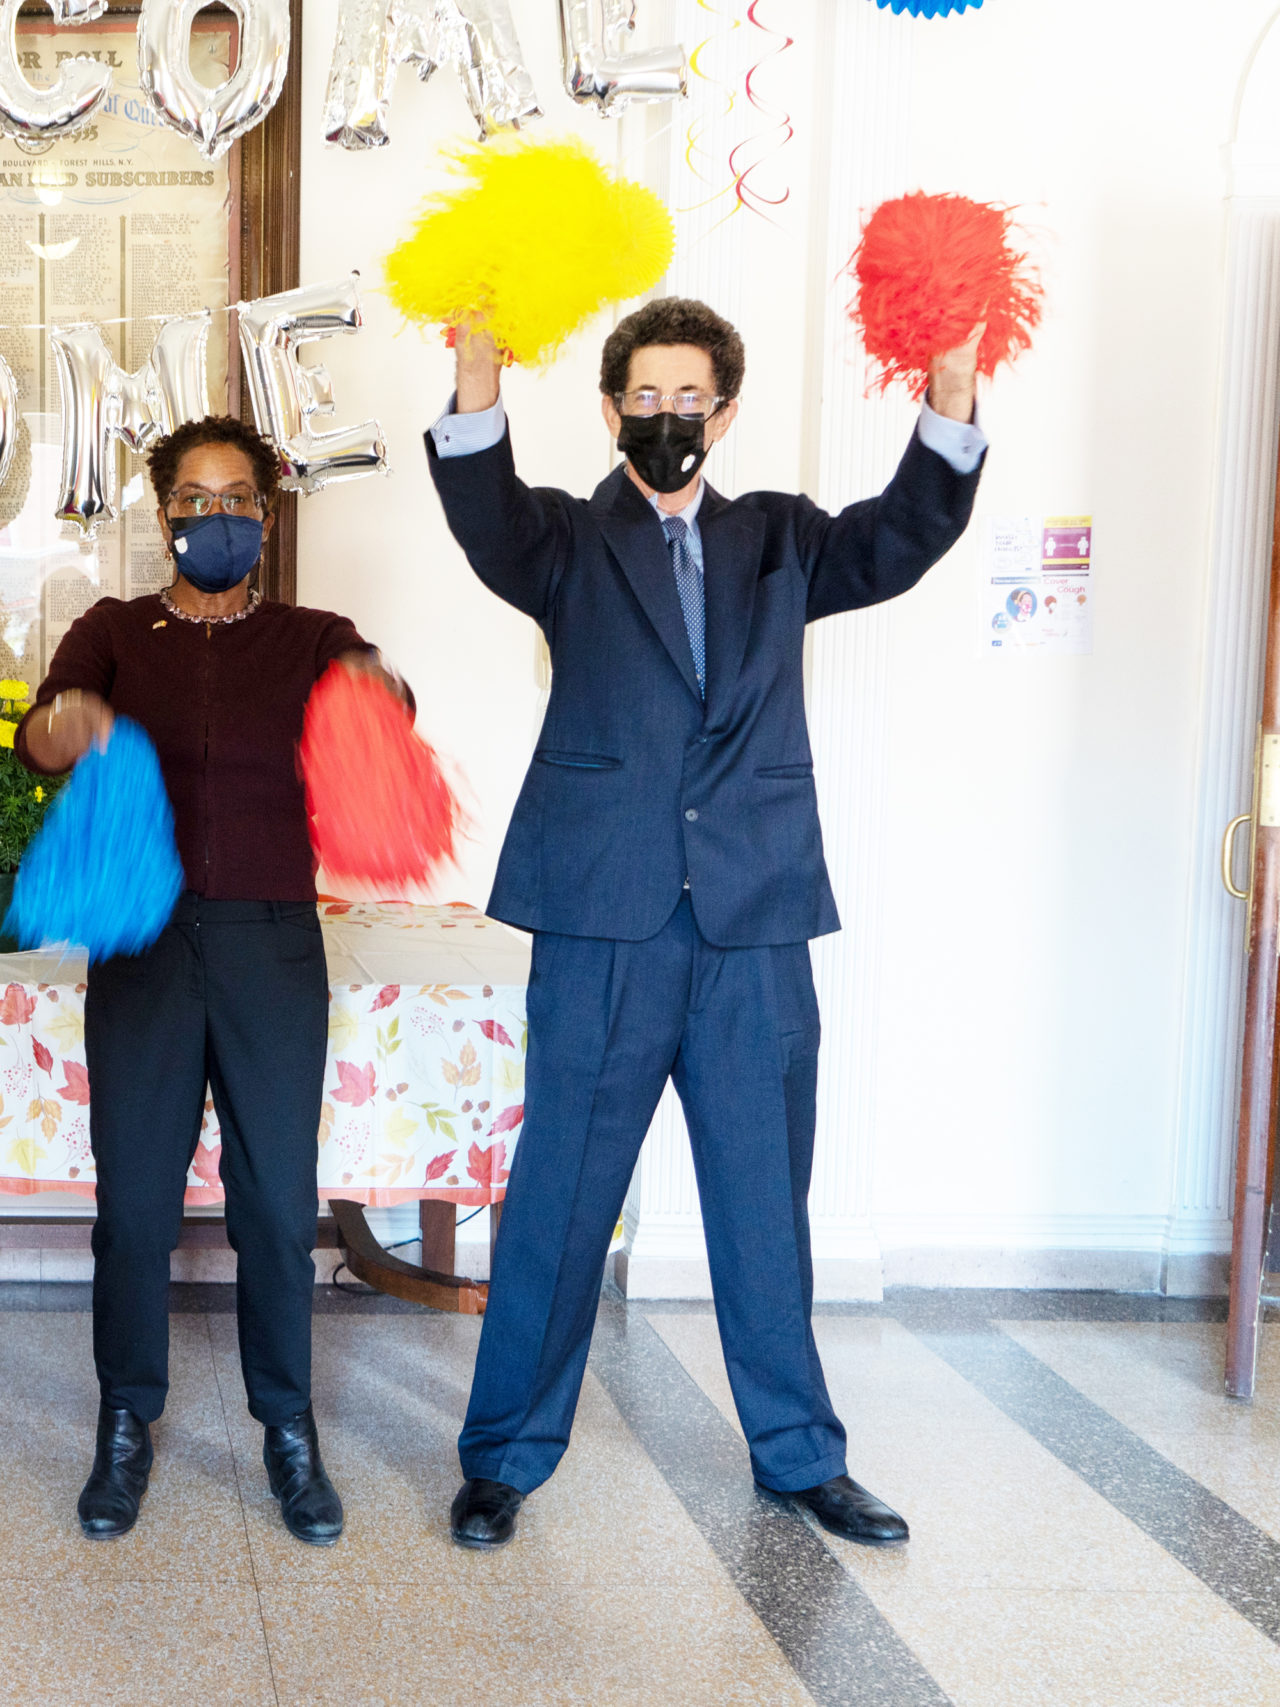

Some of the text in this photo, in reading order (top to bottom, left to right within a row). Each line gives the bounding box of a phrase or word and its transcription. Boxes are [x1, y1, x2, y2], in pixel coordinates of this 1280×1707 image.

[2, 160, 49, 168] BOULEVARD
[59, 159, 88, 167] FOREST
[85, 170, 215, 187] SUBSCRIBERS
[1056, 586, 1086, 594] Cough
